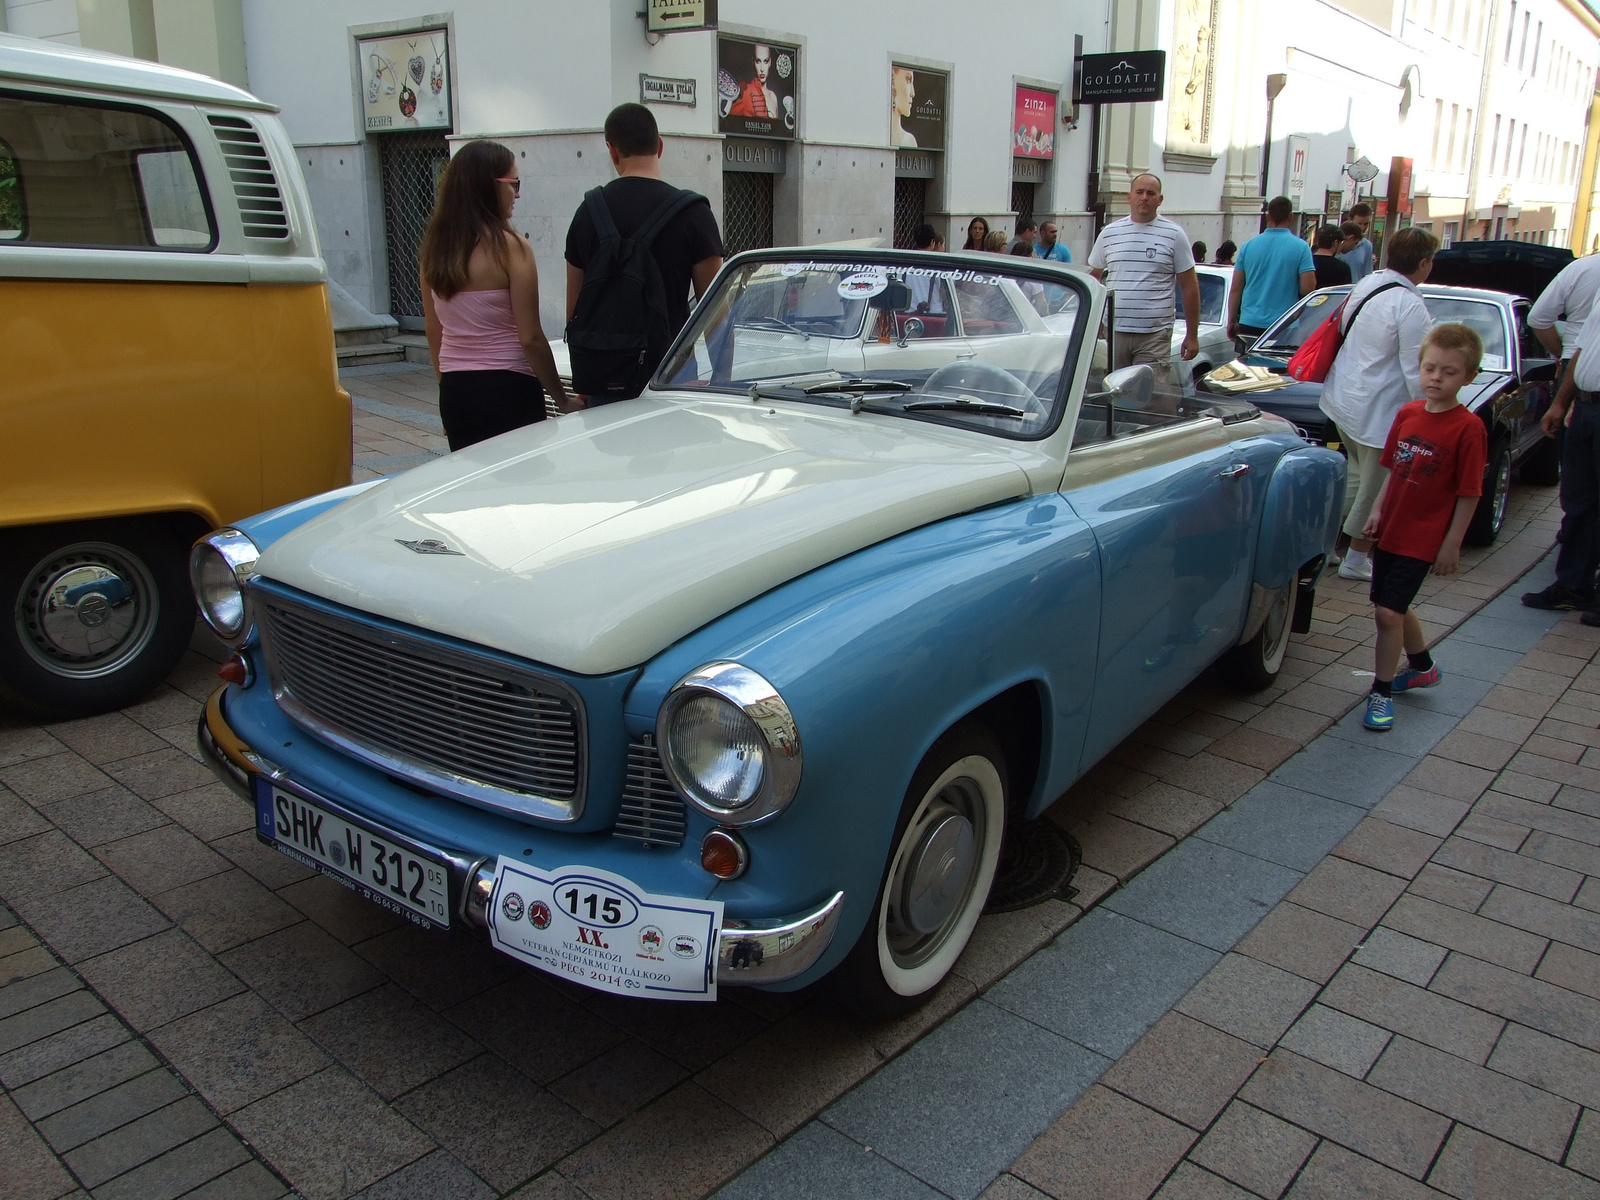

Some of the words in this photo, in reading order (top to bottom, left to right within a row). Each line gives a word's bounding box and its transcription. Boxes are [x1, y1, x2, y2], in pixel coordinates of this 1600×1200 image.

[1085, 73, 1157, 86] GOLDATTI
[916, 106, 941, 115] GOLDATTI
[726, 145, 781, 164] OLDATTI
[895, 156, 932, 171] OLDATTI
[1013, 164, 1043, 177] OLDATTI
[1411, 445, 1433, 456] BHP
[263, 813, 270, 825] D
[276, 795, 326, 856] SHK
[345, 827, 362, 875] W
[370, 839, 426, 908] 312
[277, 843, 316, 870] HERRMANN
[321, 867, 356, 891] Automobile
[428, 868, 442, 885] 05
[431, 900, 444, 916] 10
[565, 888, 621, 924] 115
[576, 926, 609, 949] XX.
[522, 938, 560, 957] VETERÁN
[611, 964, 671, 982] TALÁLKOZÓ
[562, 941, 622, 963] NEMZETKÖZI
[561, 960, 585, 976] PÉCS
[590, 970, 621, 986] 2014
